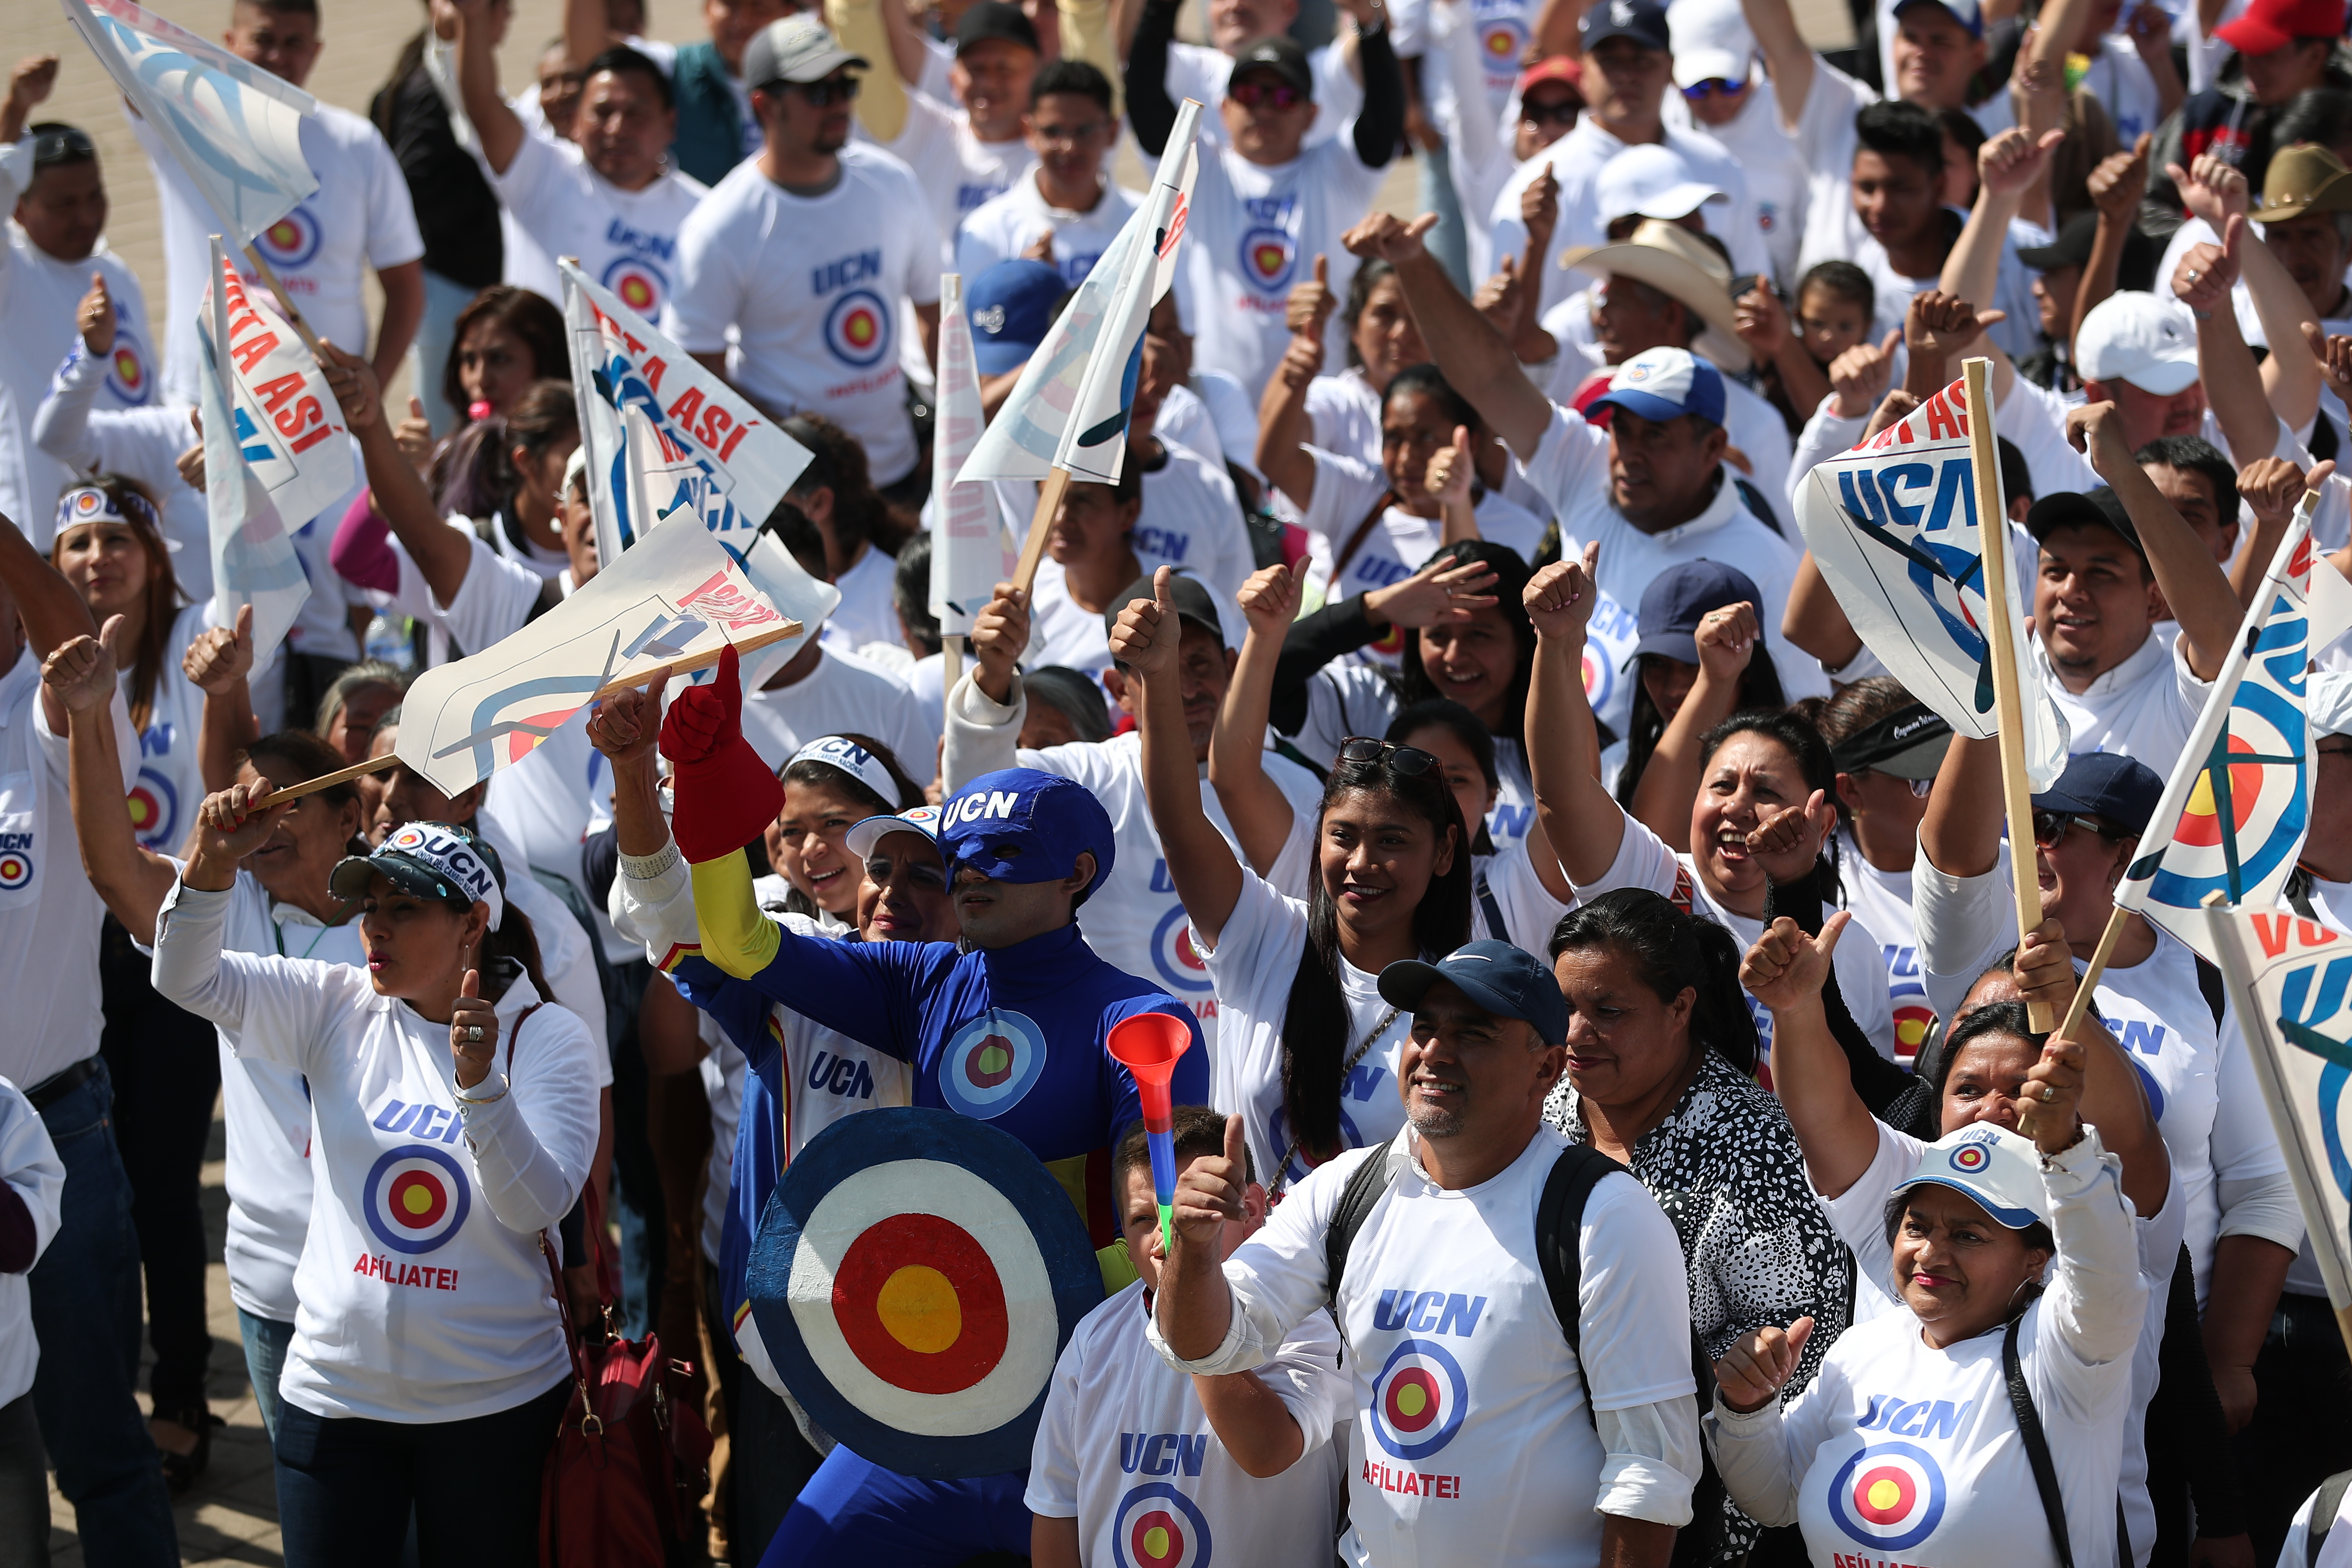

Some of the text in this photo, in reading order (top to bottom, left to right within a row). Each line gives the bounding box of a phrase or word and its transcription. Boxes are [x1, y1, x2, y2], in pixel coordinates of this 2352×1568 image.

[254, 372, 343, 455] ASÍ
[668, 386, 761, 464] ASÍ
[1926, 380, 1969, 441] AS
[1838, 458, 1980, 532] UCN
[1131, 525, 1190, 561] CN
[1357, 557, 1417, 588] UC
[943, 791, 1019, 832] UCN
[425, 836, 493, 896] UCN
[433, 859, 444, 871] DEL
[444, 866, 465, 886] CAMBIO
[462, 881, 481, 903] NACION
[808, 1050, 874, 1099] UCN
[1959, 1129, 2002, 1146] UCN
[353, 1252, 459, 1291] AFÍLIATE!
[1373, 1289, 1487, 1338] UCN
[1857, 1394, 1973, 1439] UCN
[1120, 1433, 1208, 1477] UCN
[1362, 1460, 1461, 1499] AFÍLIATE!
